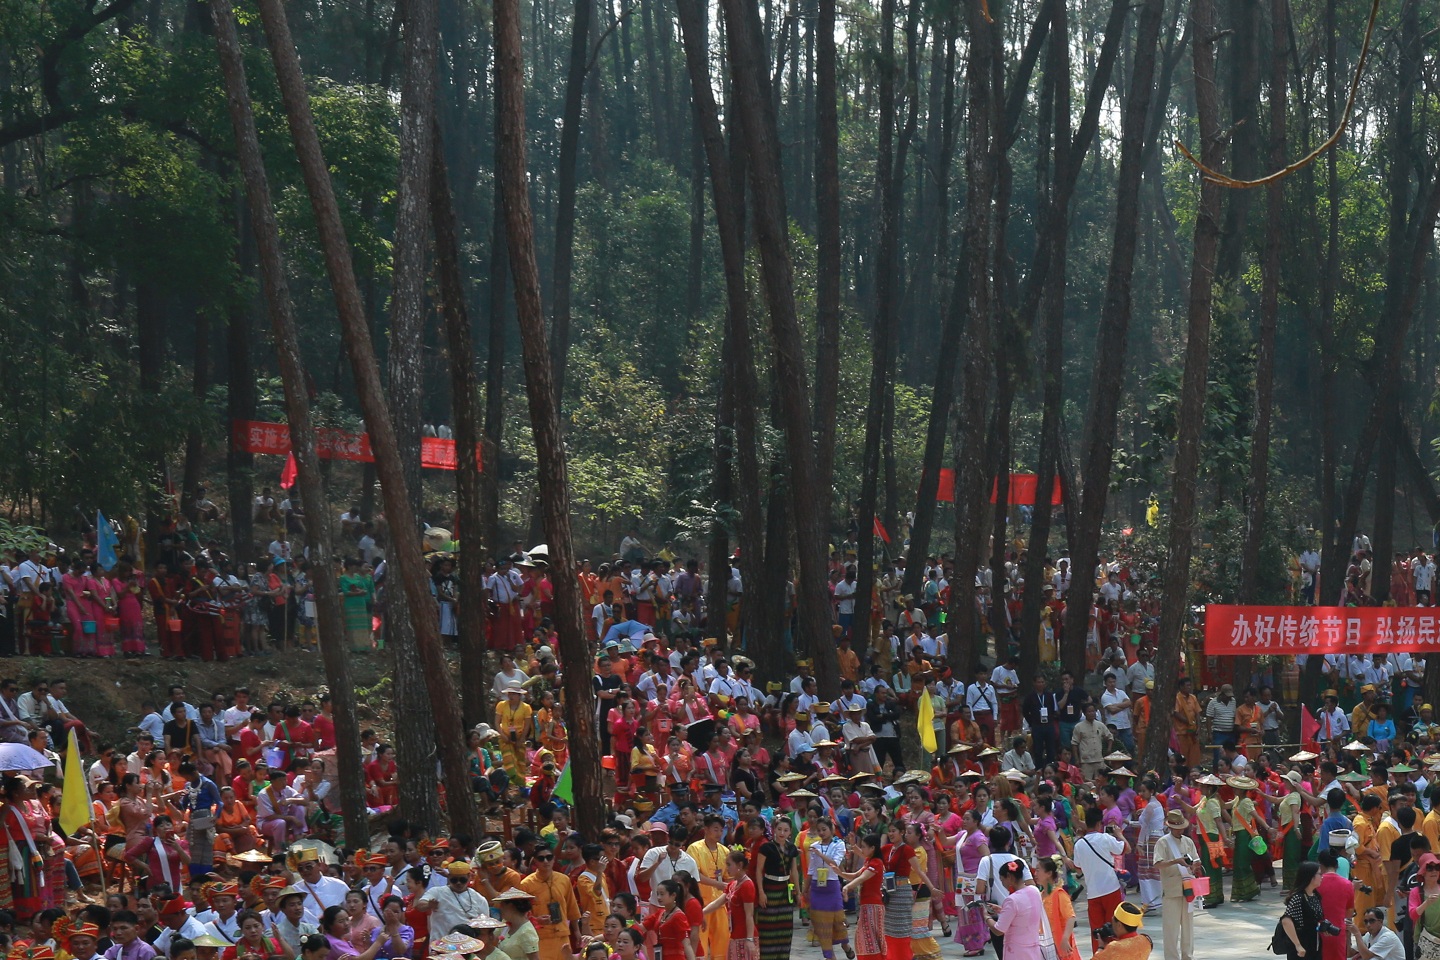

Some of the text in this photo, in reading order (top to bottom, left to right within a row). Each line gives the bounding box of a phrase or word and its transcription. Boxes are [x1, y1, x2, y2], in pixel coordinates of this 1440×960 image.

[1230, 613, 1361, 647] 办好传统节日
